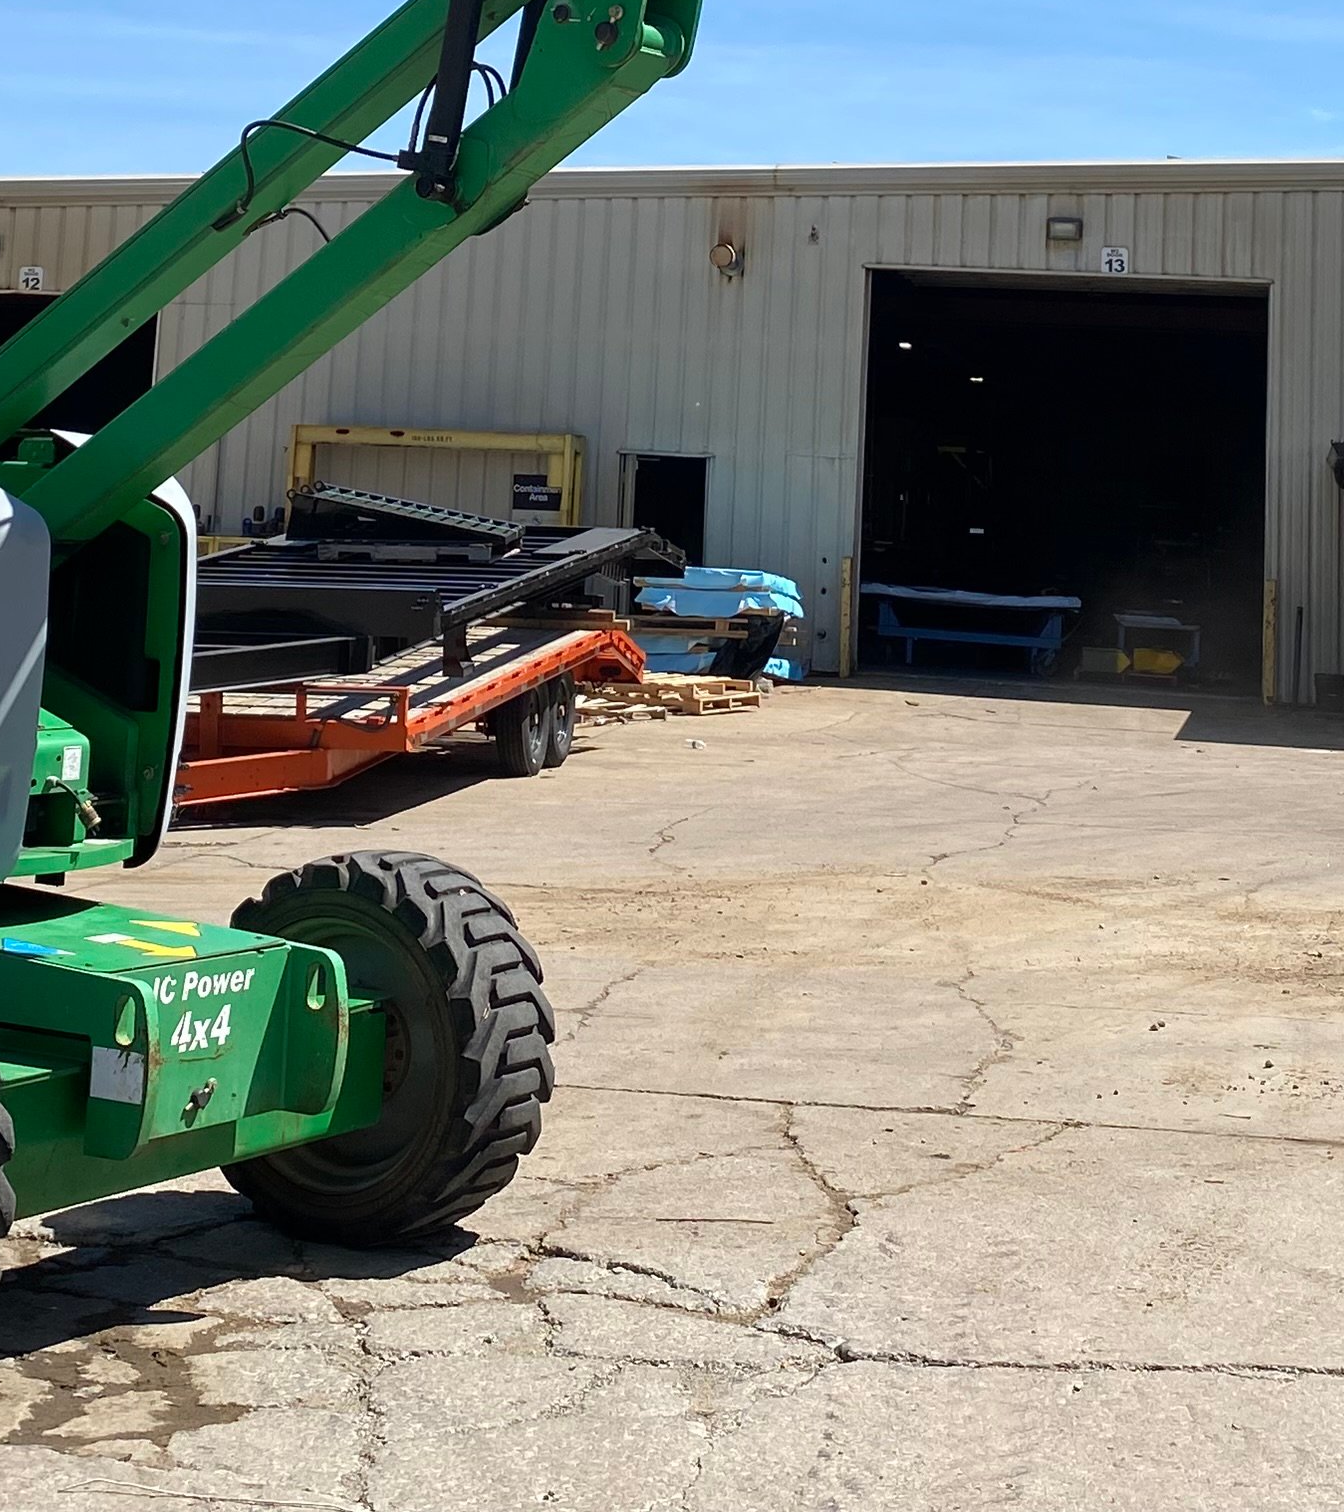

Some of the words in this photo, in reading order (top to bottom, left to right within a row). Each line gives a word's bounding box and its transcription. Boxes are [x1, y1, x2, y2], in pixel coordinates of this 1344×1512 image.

[1105, 258, 1125, 273] 13
[22, 277, 40, 290] 12
[513, 483, 561, 494] Containmen
[529, 492, 548, 502] Area
[153, 974, 177, 1005] IC
[181, 968, 255, 1001] Power
[170, 1003, 232, 1054] 4x4
